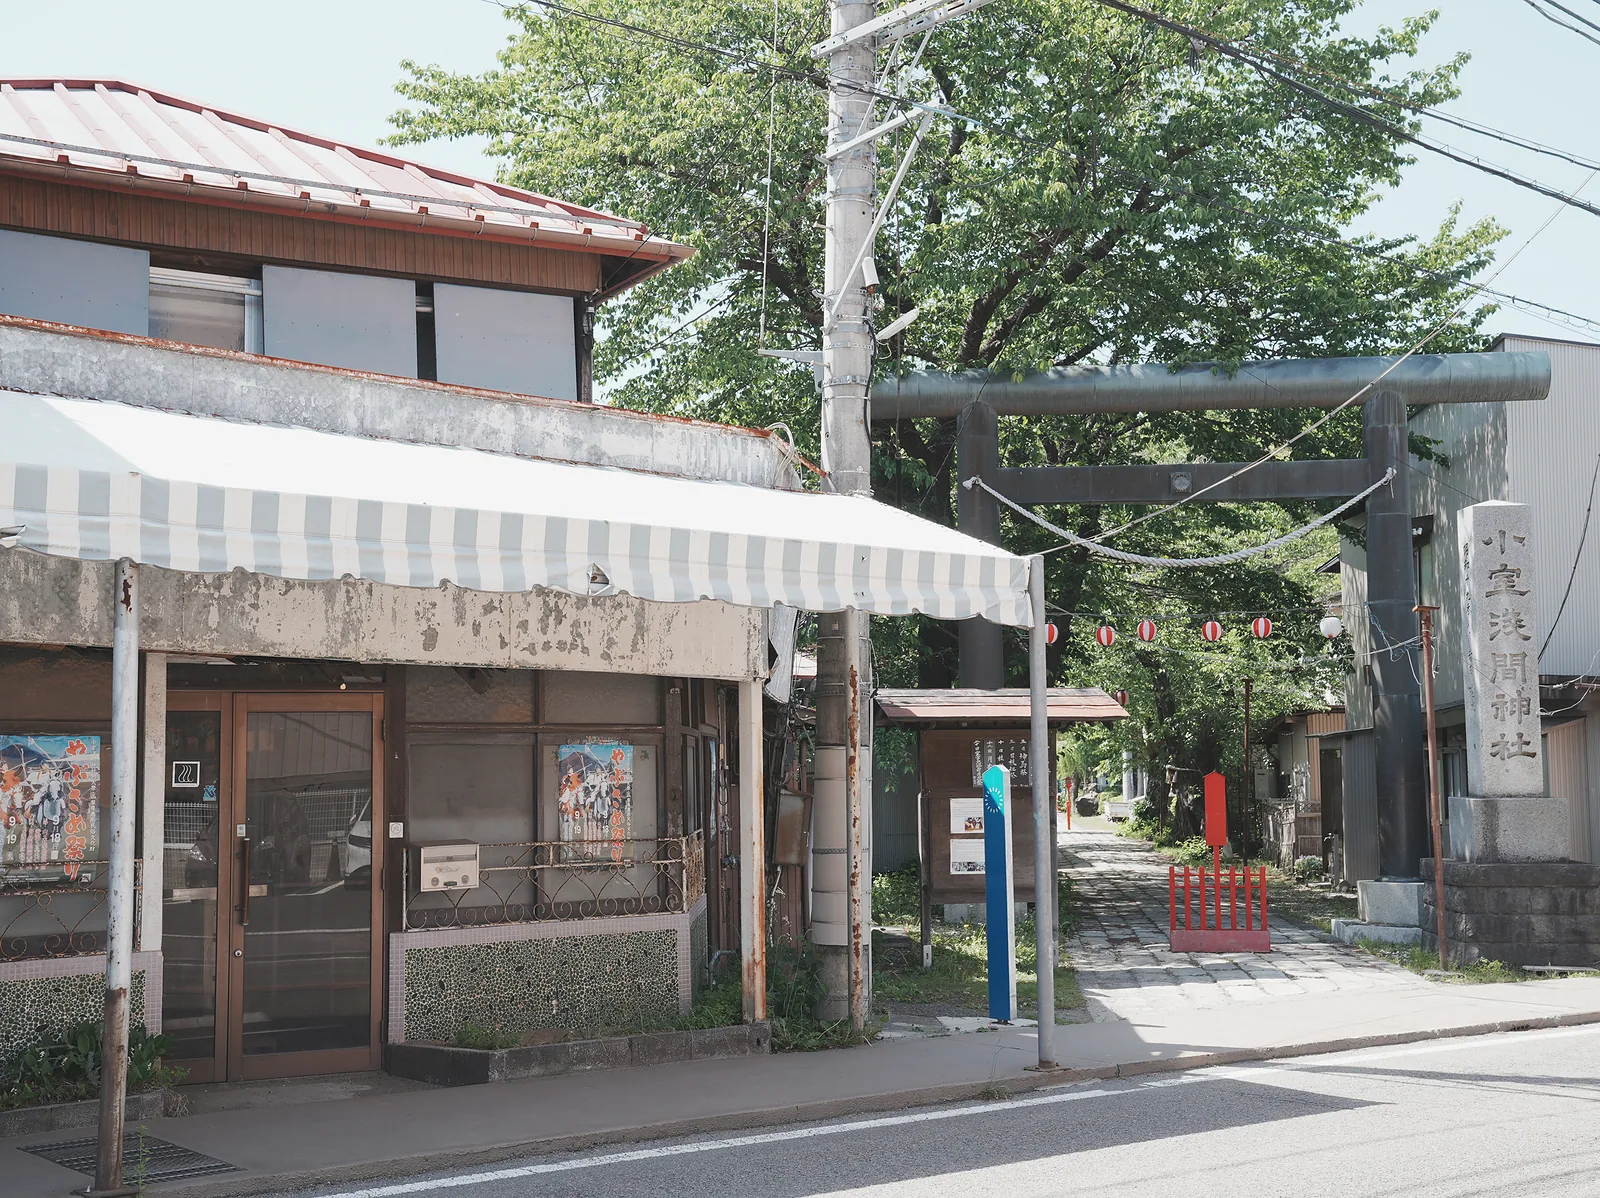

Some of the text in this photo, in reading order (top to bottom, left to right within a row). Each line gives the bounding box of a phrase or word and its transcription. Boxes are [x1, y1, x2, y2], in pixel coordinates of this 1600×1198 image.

[63, 739, 87, 881] やぶさめ祭り
[610, 748, 625, 866] やぶさめ祭り
